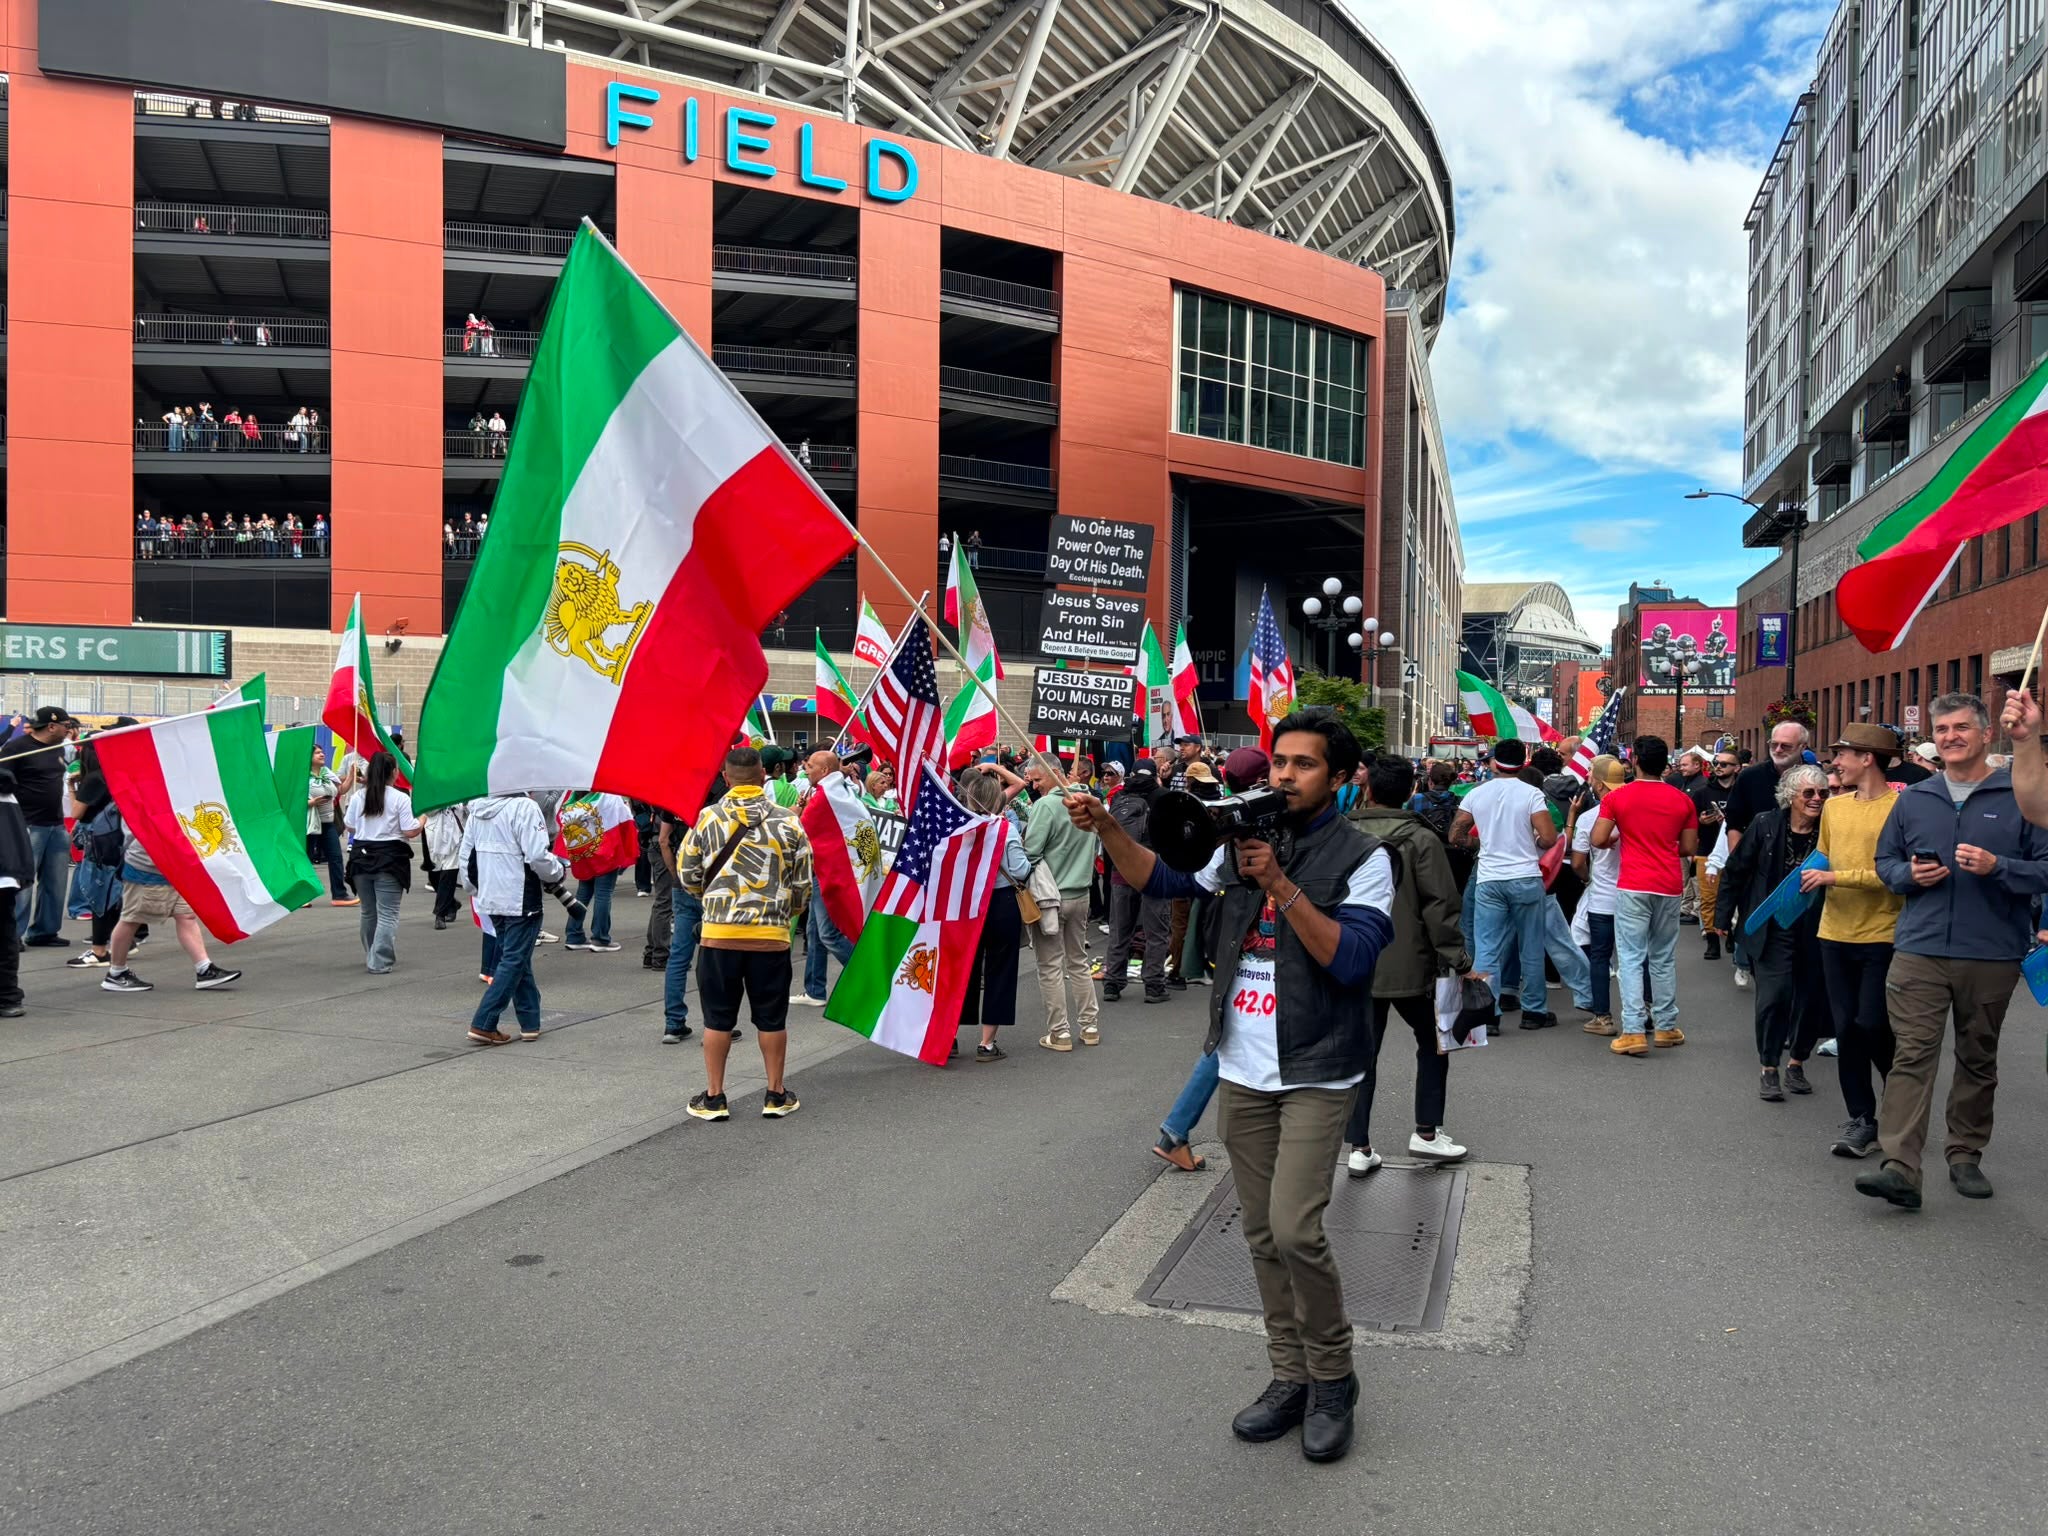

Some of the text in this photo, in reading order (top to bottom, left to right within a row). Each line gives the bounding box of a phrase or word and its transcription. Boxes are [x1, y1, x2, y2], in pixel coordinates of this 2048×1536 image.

[606, 80, 919, 203] FIELD
[1071, 519, 1135, 539] No One Has
[1057, 536, 1144, 559] Power Over The
[1050, 554, 1145, 579] Day Of His Death.
[1048, 593, 1139, 613] Jesus Saves
[1059, 610, 1125, 629] From Sin
[1042, 626, 1073, 641] And
[1076, 629, 1108, 645] Hell.
[0, 634, 119, 661] ERS FC
[857, 640, 886, 663] GRE
[1044, 643, 1066, 652] Repent
[1074, 645, 1097, 654] Believe
[1099, 647, 1109, 656] the
[1110, 649, 1134, 658] Gospel
[1043, 672, 1128, 690] JESUS SAID
[1404, 664, 1416, 679] 4
[1037, 686, 1066, 702] YOU
[1069, 690, 1108, 707] MUST
[1111, 694, 1131, 709] BE
[1037, 705, 1076, 723] BORN
[1079, 710, 1126, 728] AGAIN.
[1084, 728, 1097, 736] 3:7
[1236, 967, 1271, 981] Setayesh
